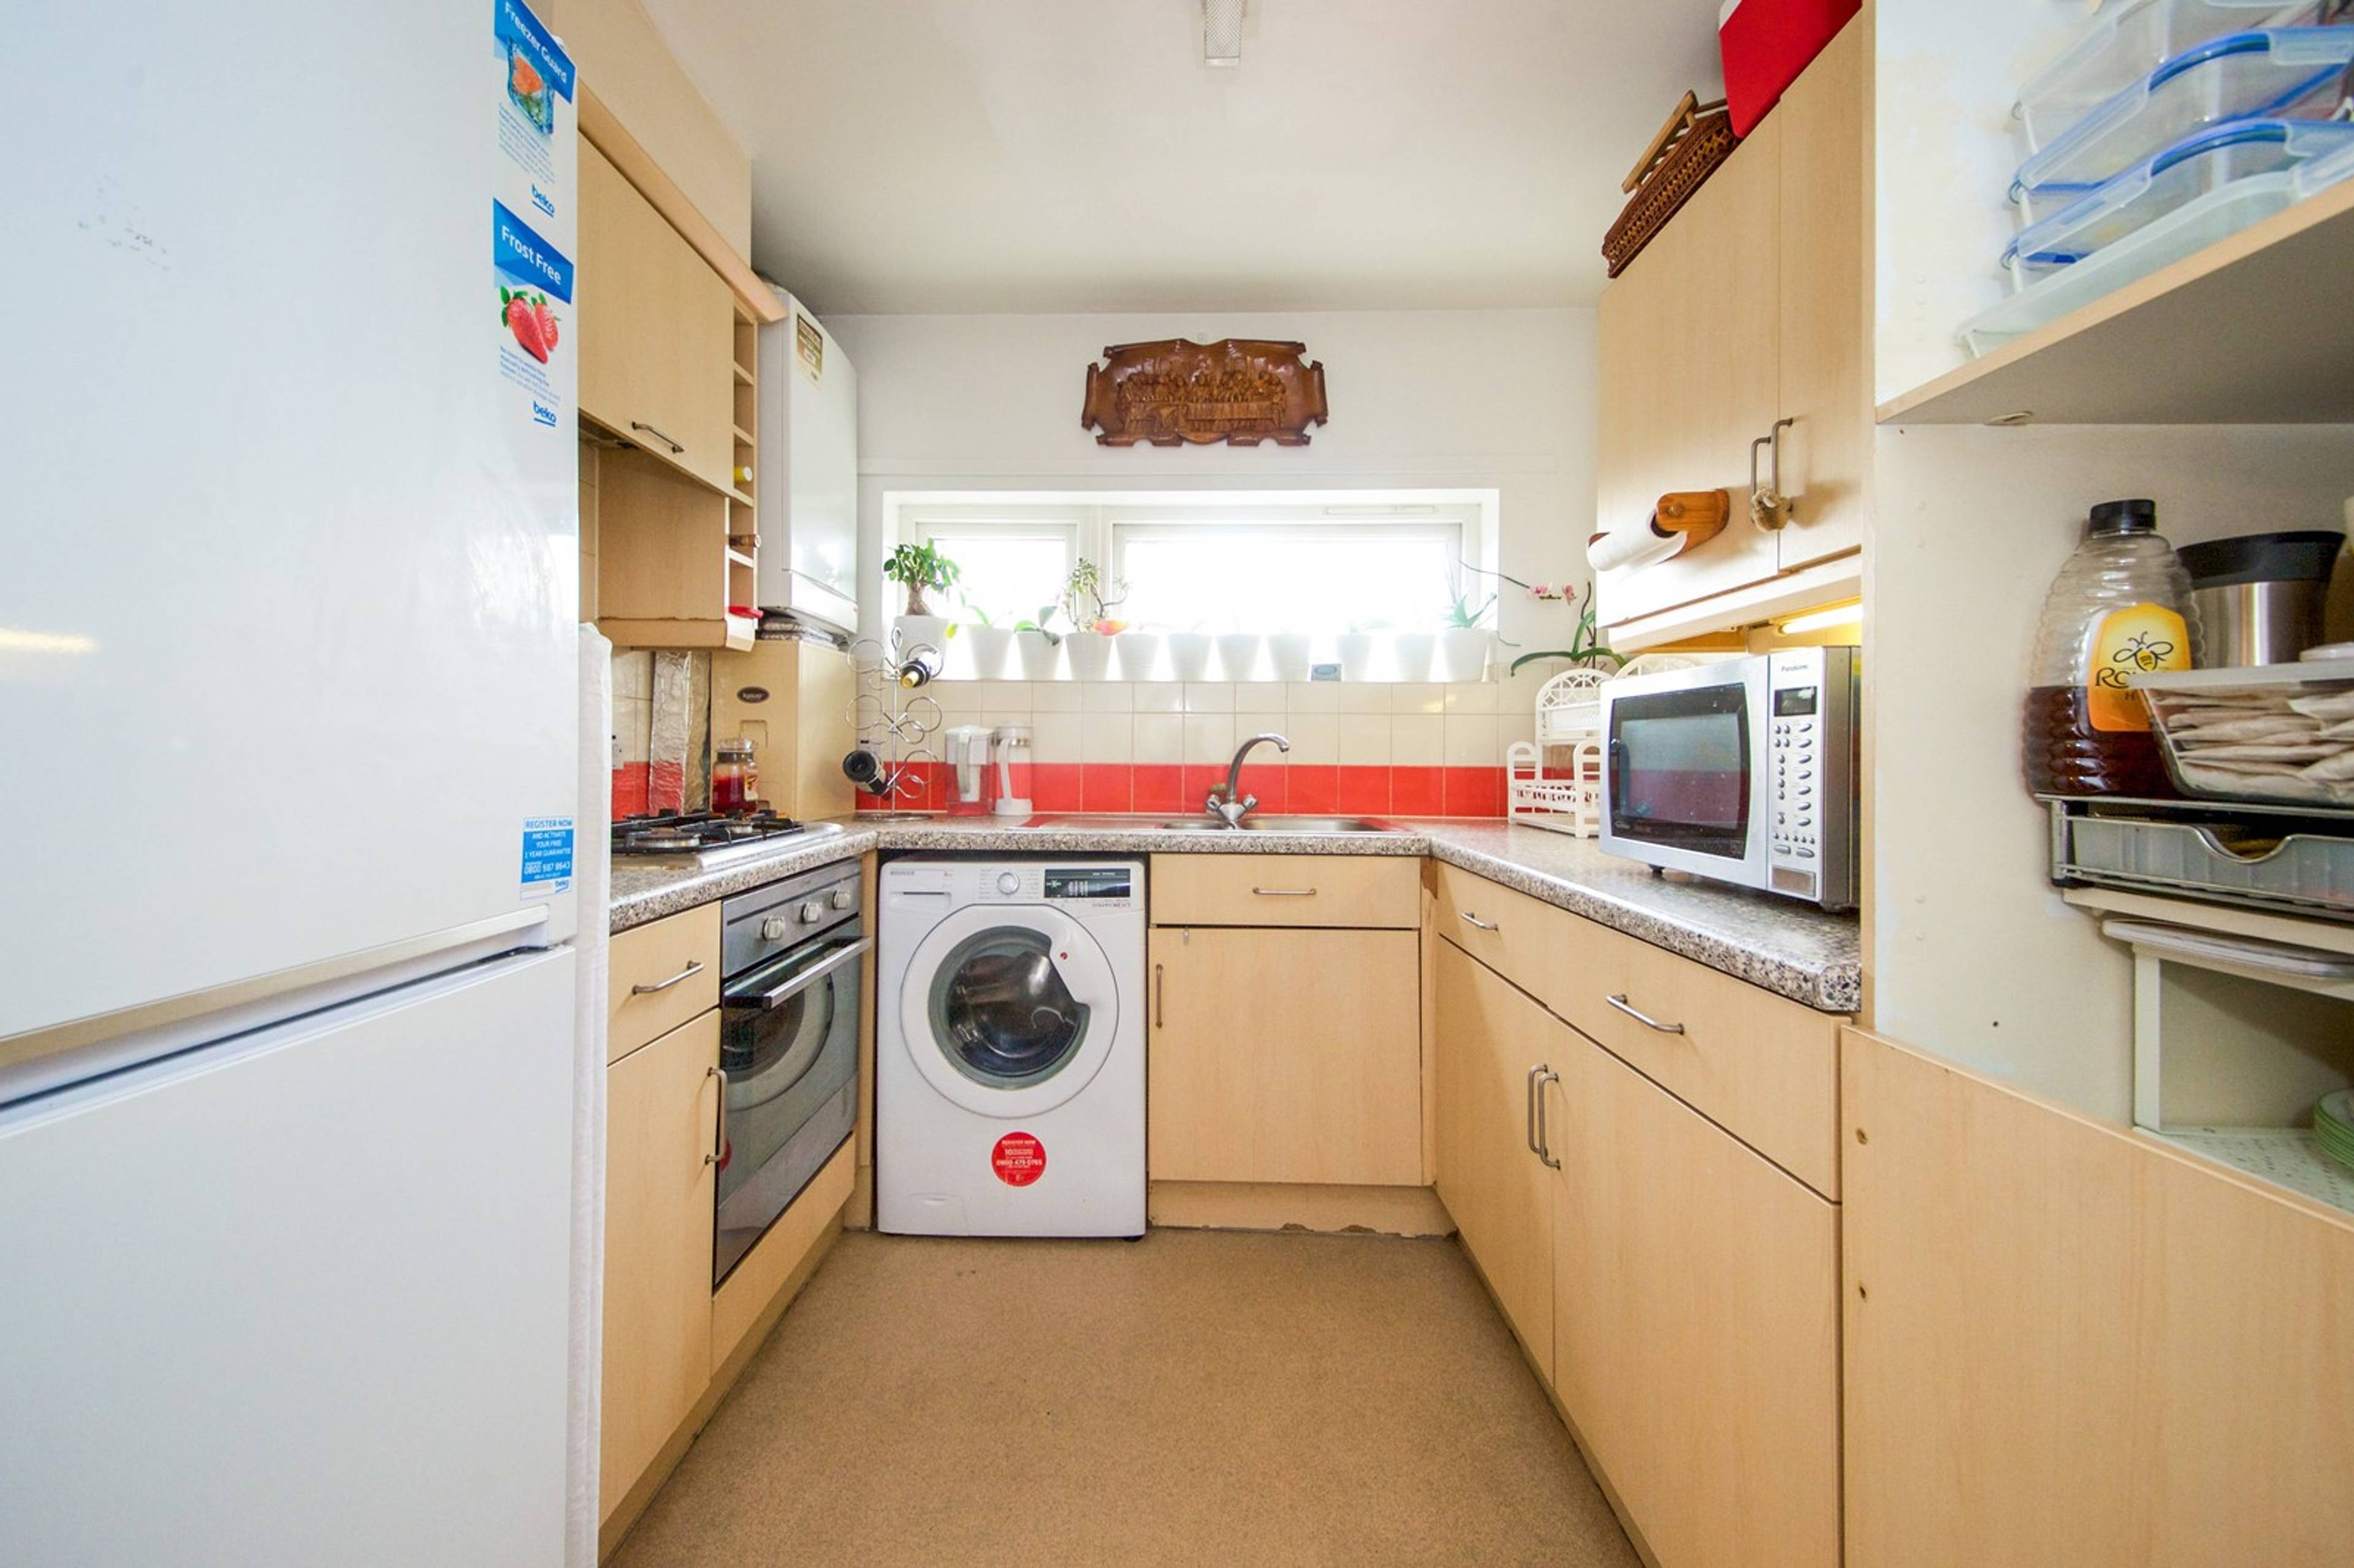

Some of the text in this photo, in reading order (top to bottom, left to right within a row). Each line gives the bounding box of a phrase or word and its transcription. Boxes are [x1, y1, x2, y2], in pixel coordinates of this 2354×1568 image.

[505, 1, 540, 51] Freezer
[531, 183, 555, 213] beko
[501, 224, 562, 286] Frost Free
[533, 400, 557, 424] beko
[525, 820, 557, 829] REGISTER
